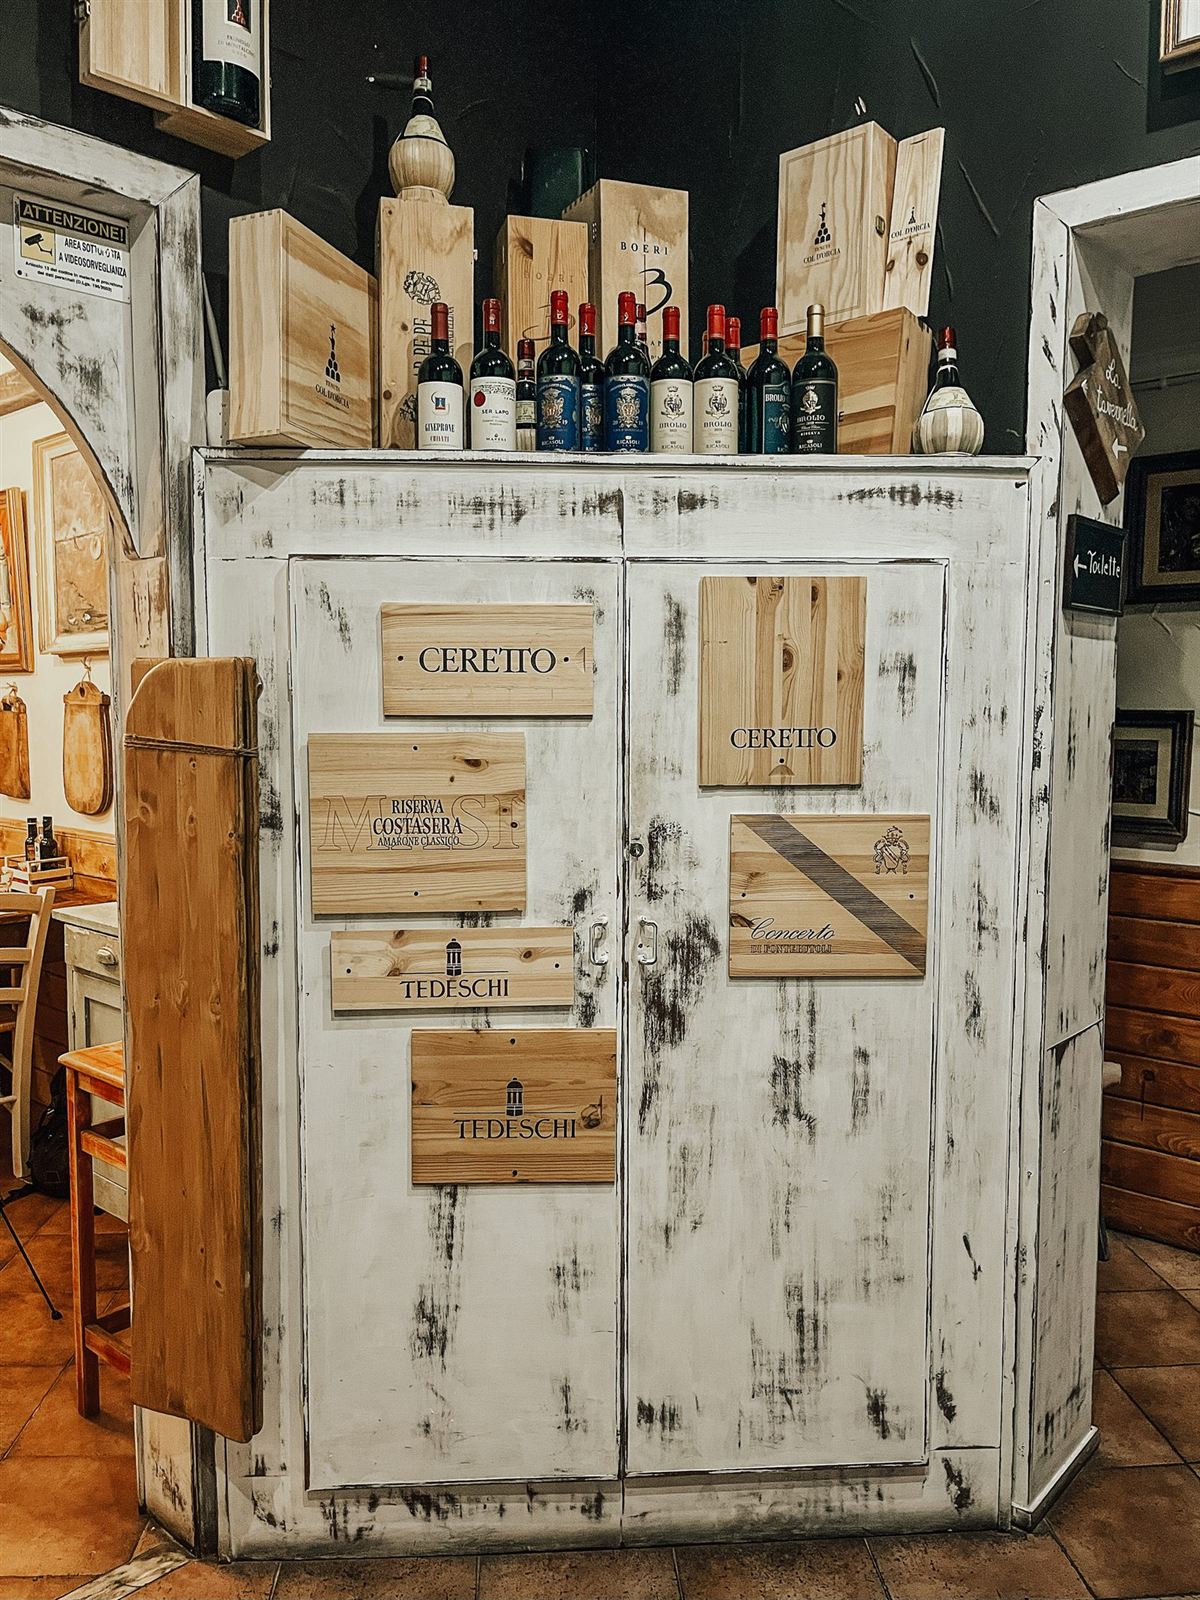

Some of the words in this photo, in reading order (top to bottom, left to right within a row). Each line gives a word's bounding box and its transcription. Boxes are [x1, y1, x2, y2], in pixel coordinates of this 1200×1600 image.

[23, 203, 125, 242] ATTENZIONE!
[891, 231, 903, 239] COL
[904, 222, 931, 235] D'ORCIA
[64, 238, 81, 251] AREA
[620, 241, 669, 256] BOERI
[803, 255, 816, 264] COL
[816, 248, 841, 261] D'ORCIA
[58, 252, 64, 262] A
[64, 252, 127, 278] VIDEOSORVEGLIANZA
[315, 383, 328, 398] COL
[765, 393, 786, 402] BROLIO
[796, 414, 826, 423] BROLIO
[1087, 550, 1121, 578] Toilette
[418, 647, 557, 674] CERETTO
[730, 727, 837, 749] CERETTO
[391, 799, 444, 814] RISERVA
[372, 817, 463, 835] COSTASERA
[377, 836, 420, 847] AMARONE
[420, 836, 460, 847] CLASSICO
[749, 917, 835, 940] Concerto
[399, 978, 509, 998] TEDESCHI
[453, 1118, 576, 1140] TEDESCHI
